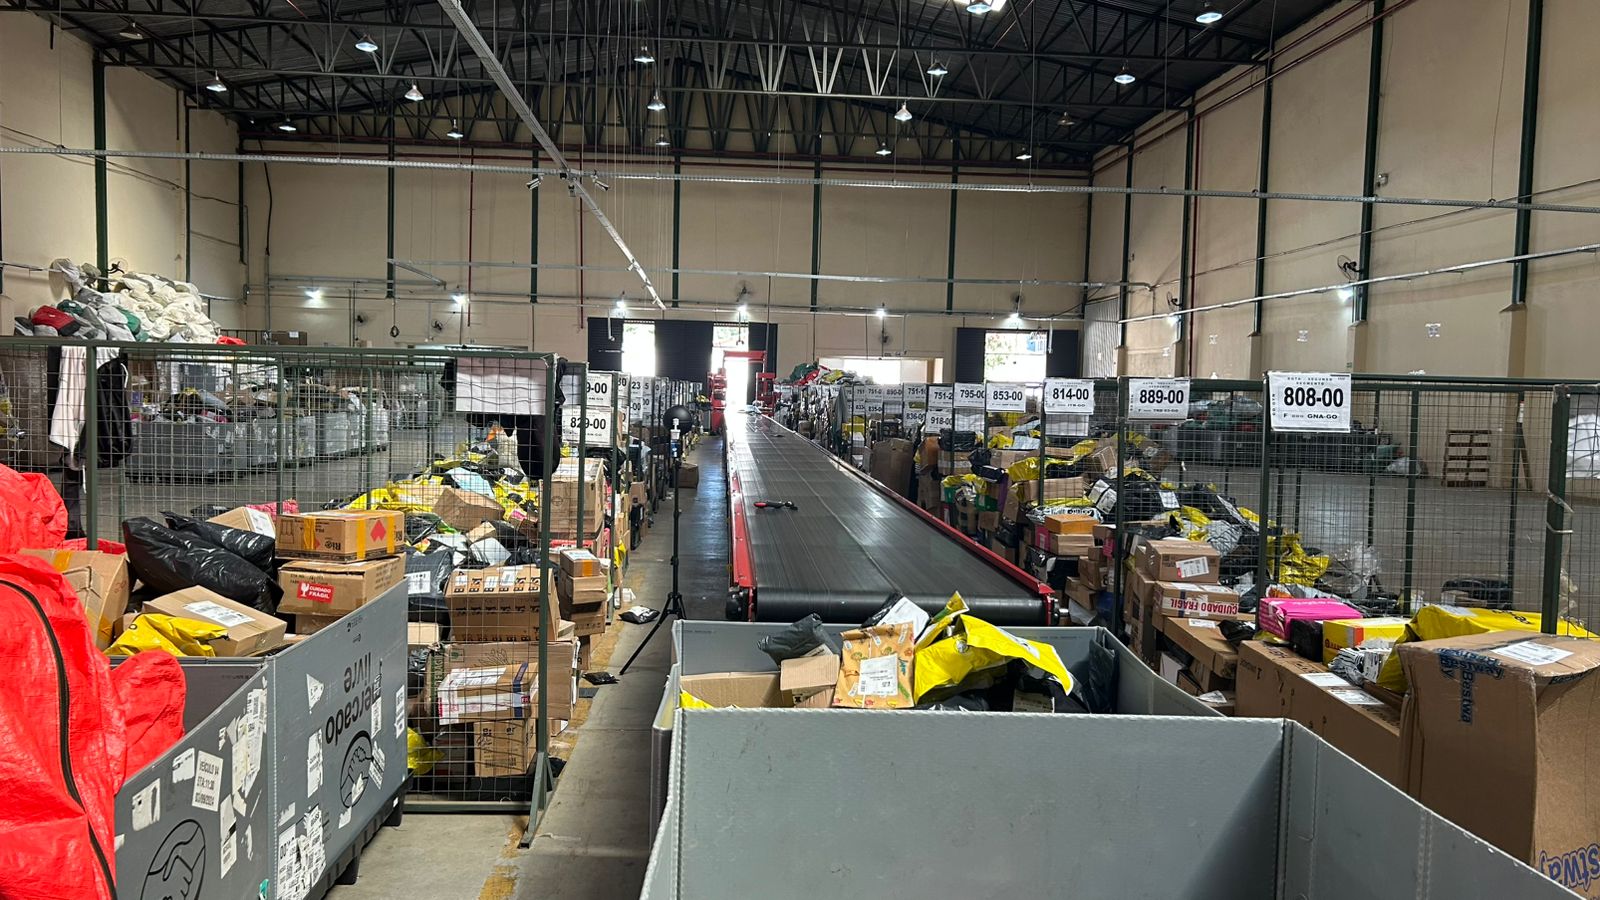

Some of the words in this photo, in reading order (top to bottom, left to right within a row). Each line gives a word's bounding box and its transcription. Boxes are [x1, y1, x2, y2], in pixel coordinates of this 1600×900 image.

[992, 390, 1023, 401] 853-00
[1052, 387, 1089, 400] 814-00
[1139, 389, 1184, 404] 889-00
[1283, 386, 1344, 408] 808-00
[1201, 602, 1238, 615] CUIDADO
[344, 651, 371, 694] livre
